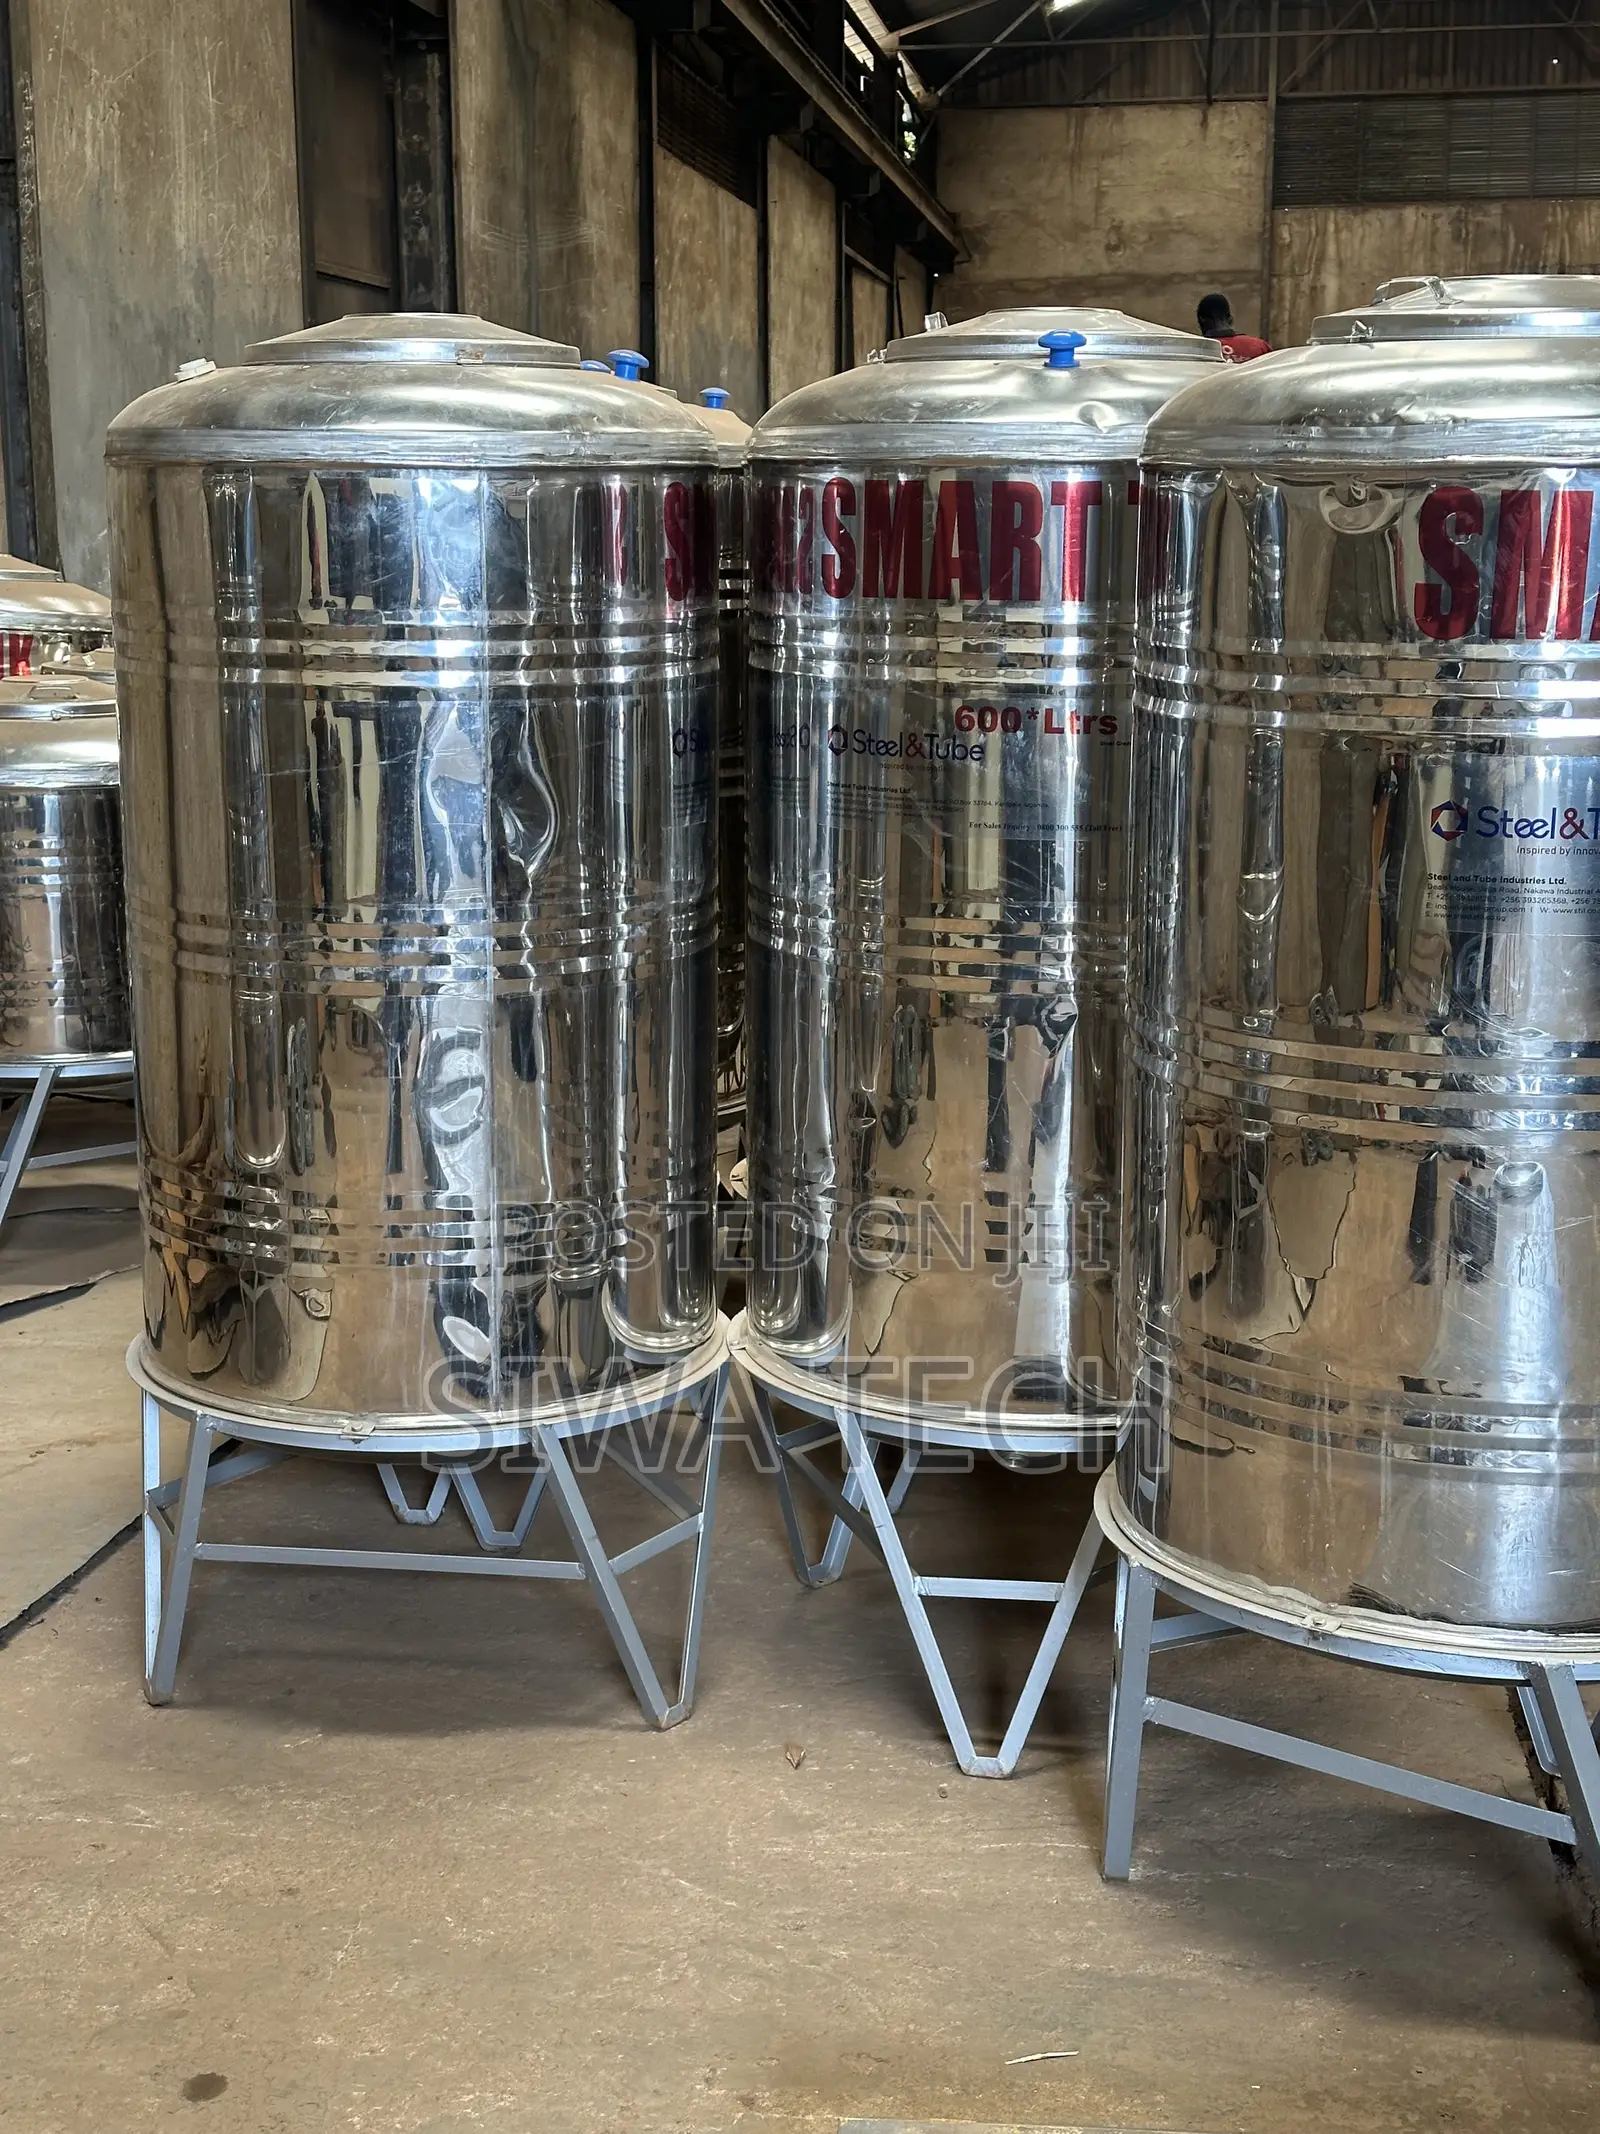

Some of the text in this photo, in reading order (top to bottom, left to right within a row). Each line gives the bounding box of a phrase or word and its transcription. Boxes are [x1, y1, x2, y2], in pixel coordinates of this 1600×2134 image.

[821, 477, 1102, 602] SMART
[1414, 485, 1600, 641] SM
[852, 728, 986, 762] Steel&Tube
[983, 821, 1001, 830] Sales
[1516, 845, 1557, 857] Inspired
[1559, 846, 1572, 856] by
[1427, 872, 1567, 885] Steel and Tube Industries Ltd.
[1556, 888, 1594, 896] Industrial
